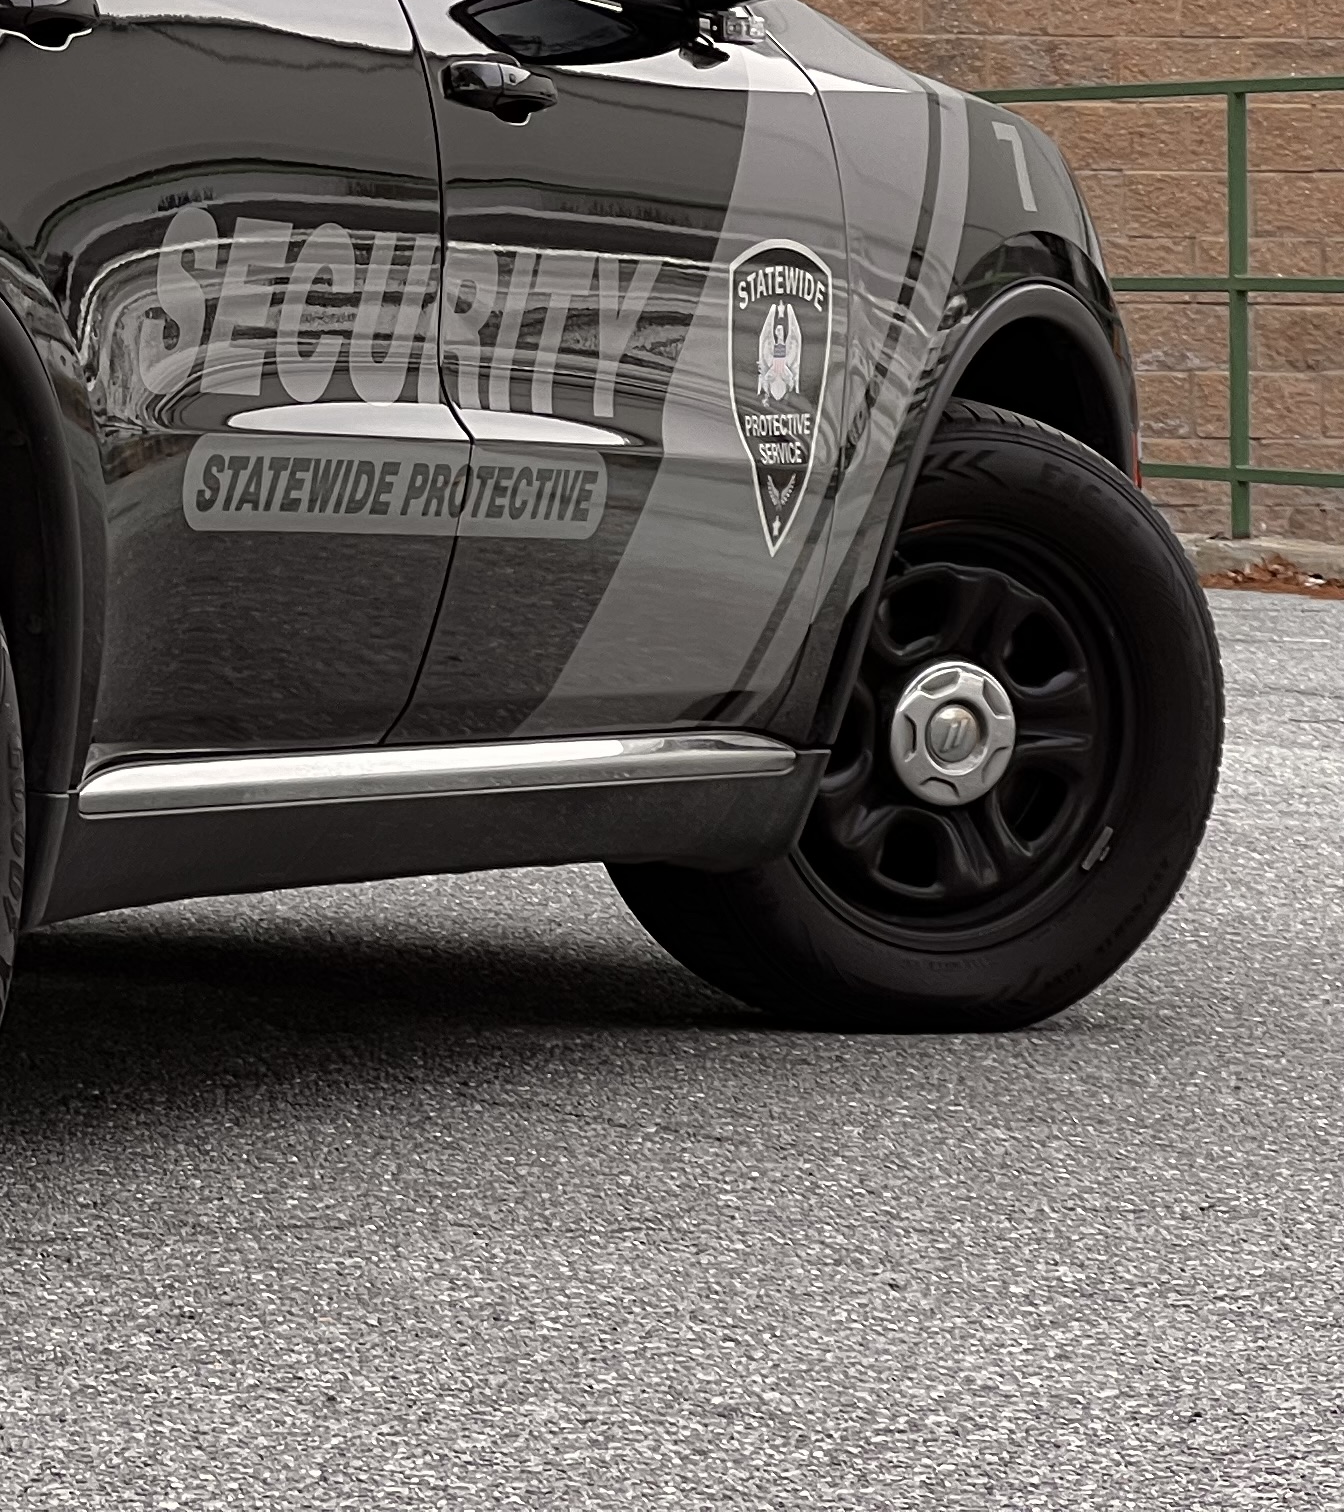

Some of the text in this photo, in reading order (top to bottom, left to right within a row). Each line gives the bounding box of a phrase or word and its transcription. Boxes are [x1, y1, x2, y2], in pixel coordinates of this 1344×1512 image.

[992, 121, 1038, 212] 7
[138, 206, 663, 418] SECURITY
[737, 265, 826, 312] STATEWIDE
[745, 413, 811, 436] PROTECTIVE
[758, 442, 802, 465] SERVICE
[195, 453, 599, 523] STATEWIDE PROTECTIVE
